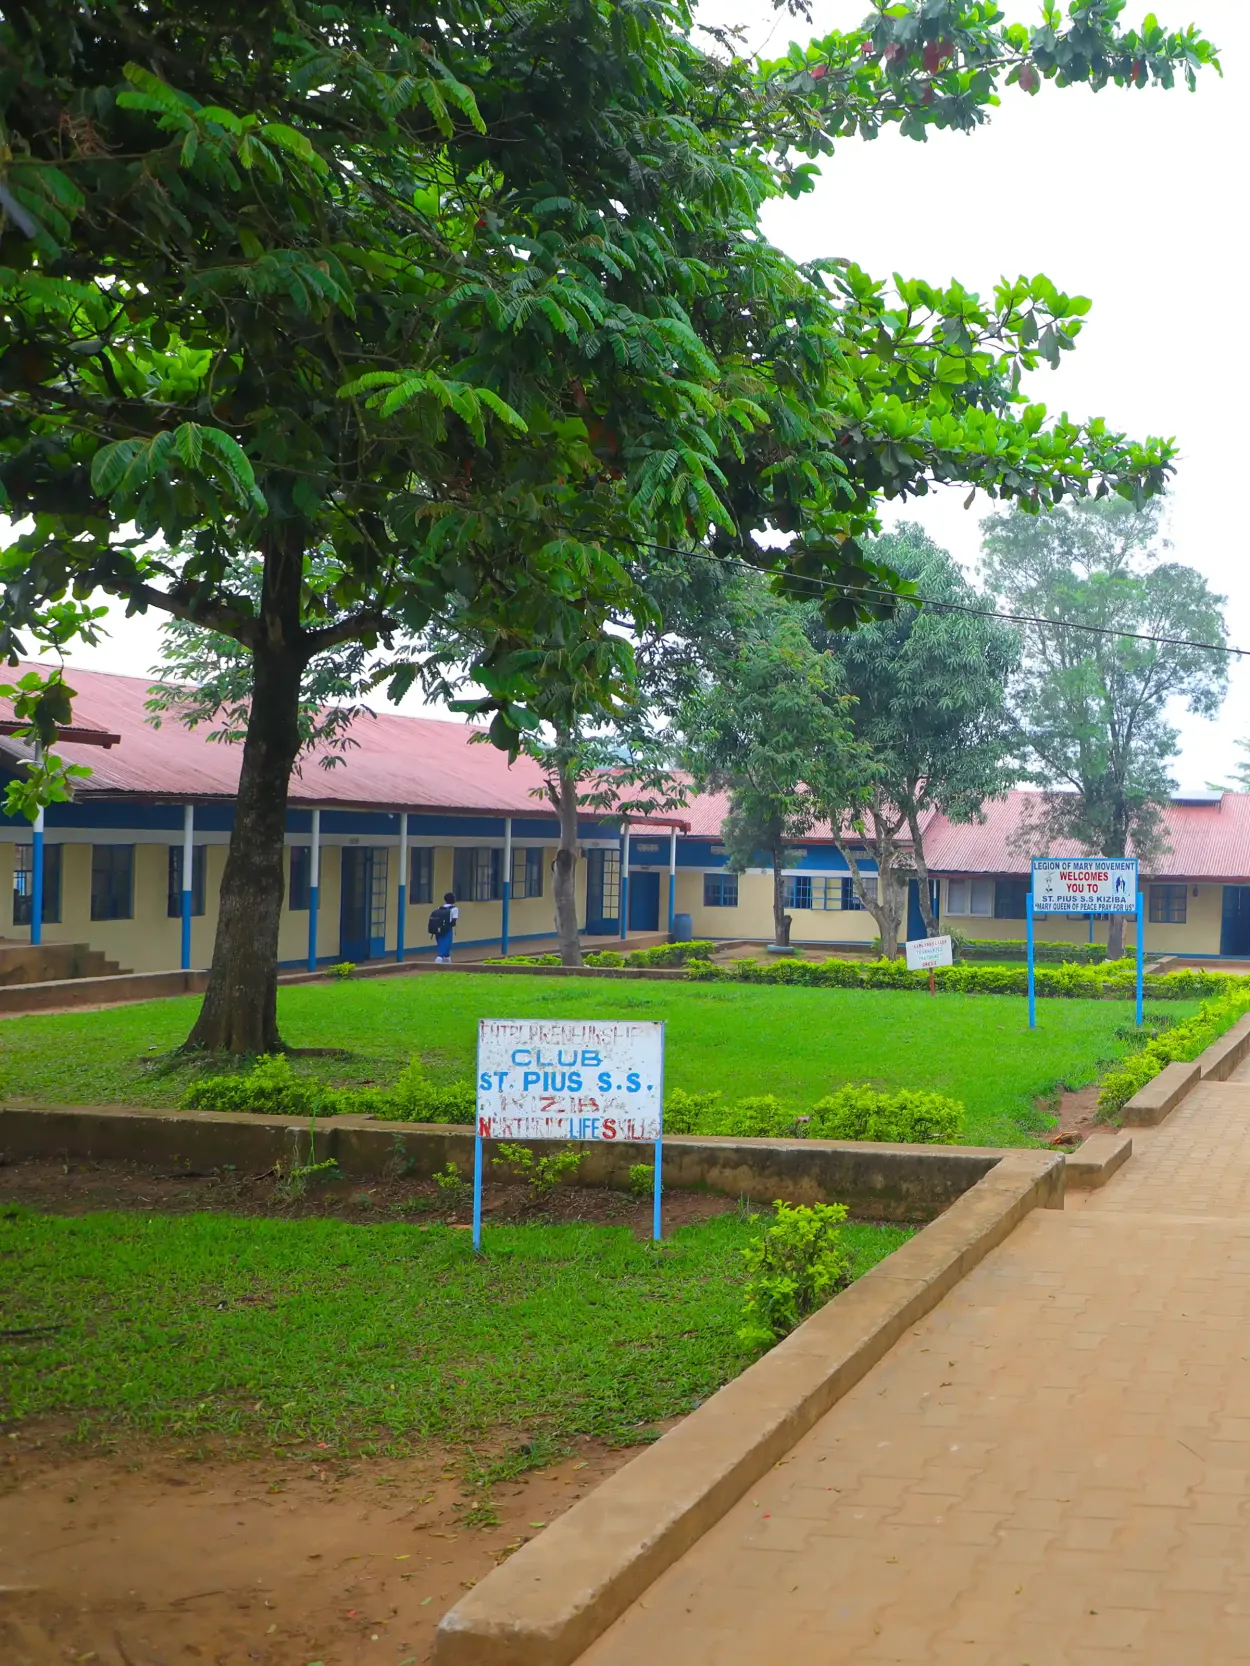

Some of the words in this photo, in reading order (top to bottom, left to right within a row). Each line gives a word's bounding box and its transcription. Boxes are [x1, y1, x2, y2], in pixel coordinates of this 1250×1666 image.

[1034, 862, 1060, 870] LEGION
[1062, 862, 1071, 870] OF
[1073, 862, 1093, 870] MARY
[1095, 862, 1135, 870] MOVEMENT
[1060, 872, 1108, 881] WELCOMES
[1066, 884, 1084, 893] YOU
[1087, 884, 1098, 893] TO
[512, 1048, 602, 1067] CLUB
[523, 1071, 583, 1092] PIUS
[598, 1072, 653, 1092] S.S.
[501, 1095, 629, 1114] KIZIBA
[569, 1118, 600, 1139] LIFE
